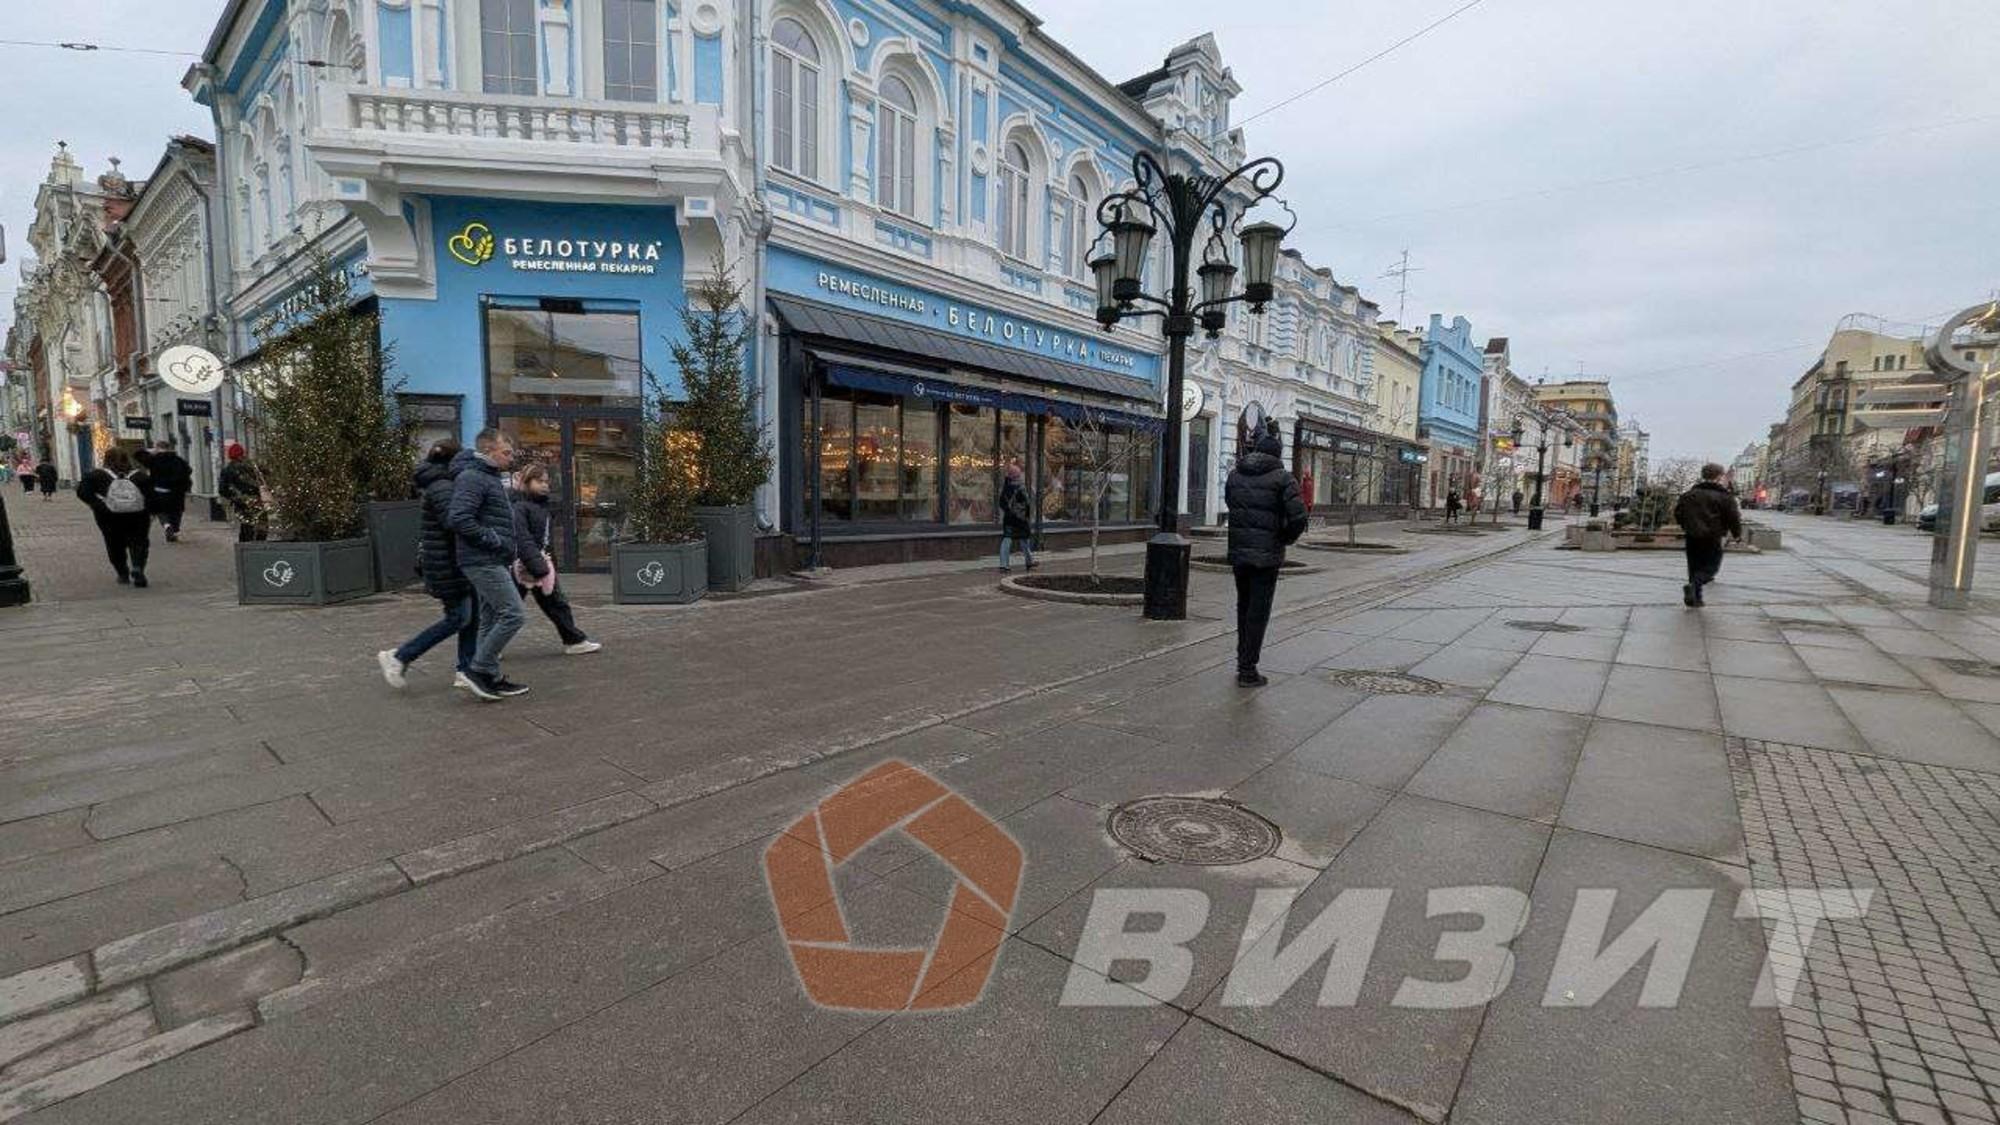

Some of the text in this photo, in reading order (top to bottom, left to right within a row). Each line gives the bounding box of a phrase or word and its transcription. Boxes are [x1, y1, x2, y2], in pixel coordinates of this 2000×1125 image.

[504, 238, 660, 260] БЕЛОТУРКА
[512, 260, 654, 274] РЕМЕСЛЕННАЯ ПЕКАРНЯ
[818, 271, 925, 313] РЕМЕСЛЕННАЯ
[948, 306, 1088, 359] БЕЛОТУРКА
